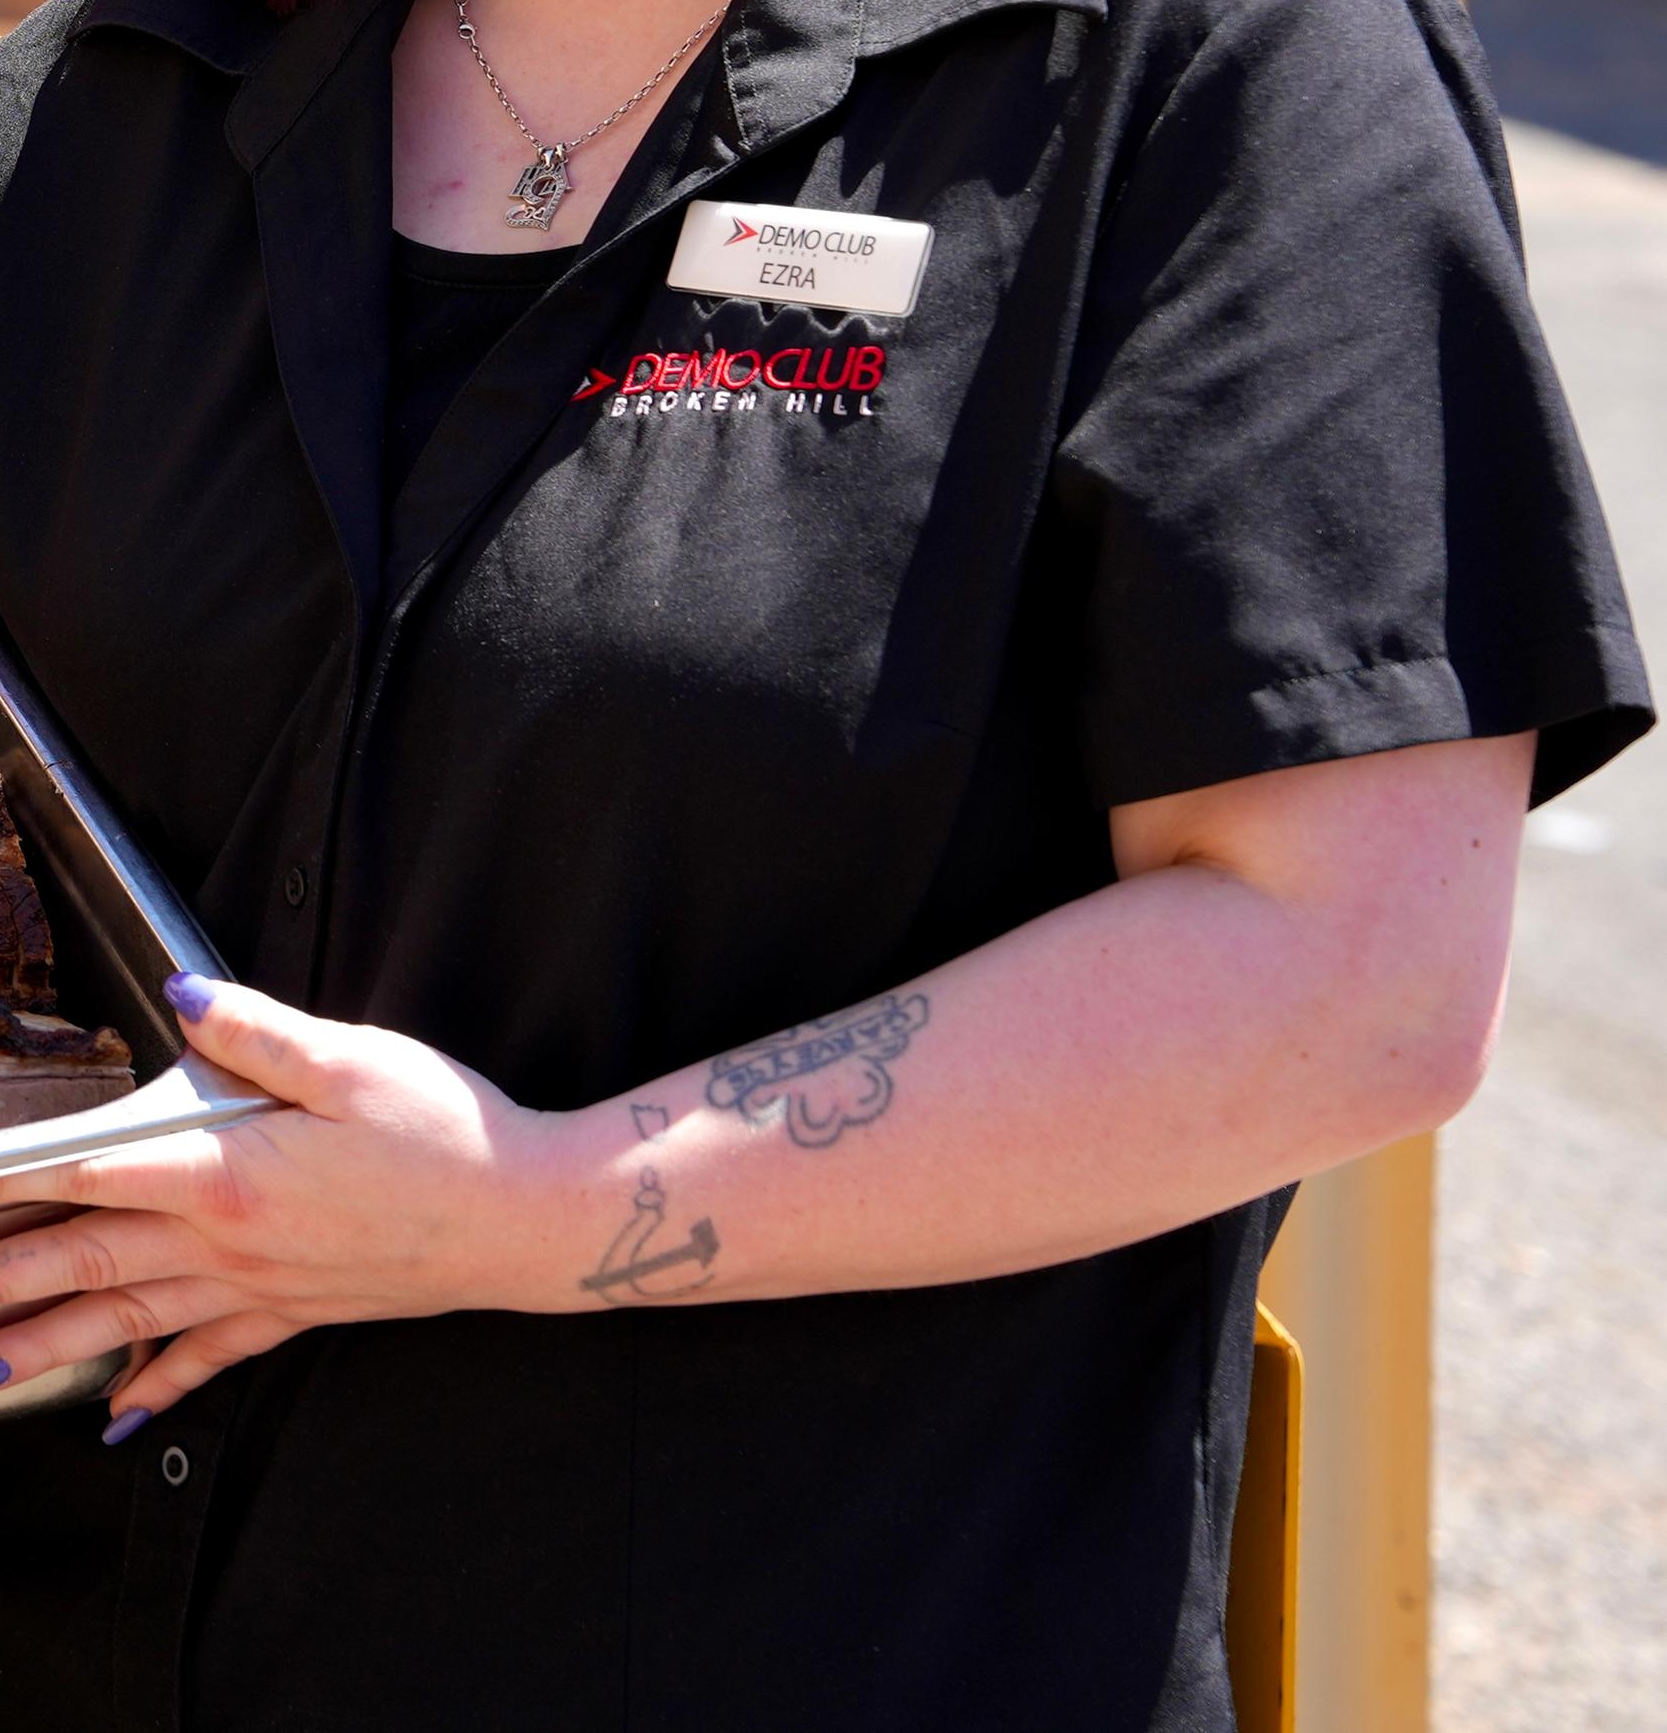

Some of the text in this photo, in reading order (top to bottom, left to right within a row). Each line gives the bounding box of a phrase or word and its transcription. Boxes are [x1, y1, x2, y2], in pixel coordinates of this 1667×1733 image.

[759, 224, 877, 256] DEMO CLUB
[759, 262, 816, 289] EZRA
[621, 345, 886, 395] DEMO CLUB
[610, 390, 874, 417] BROKEN HILL
